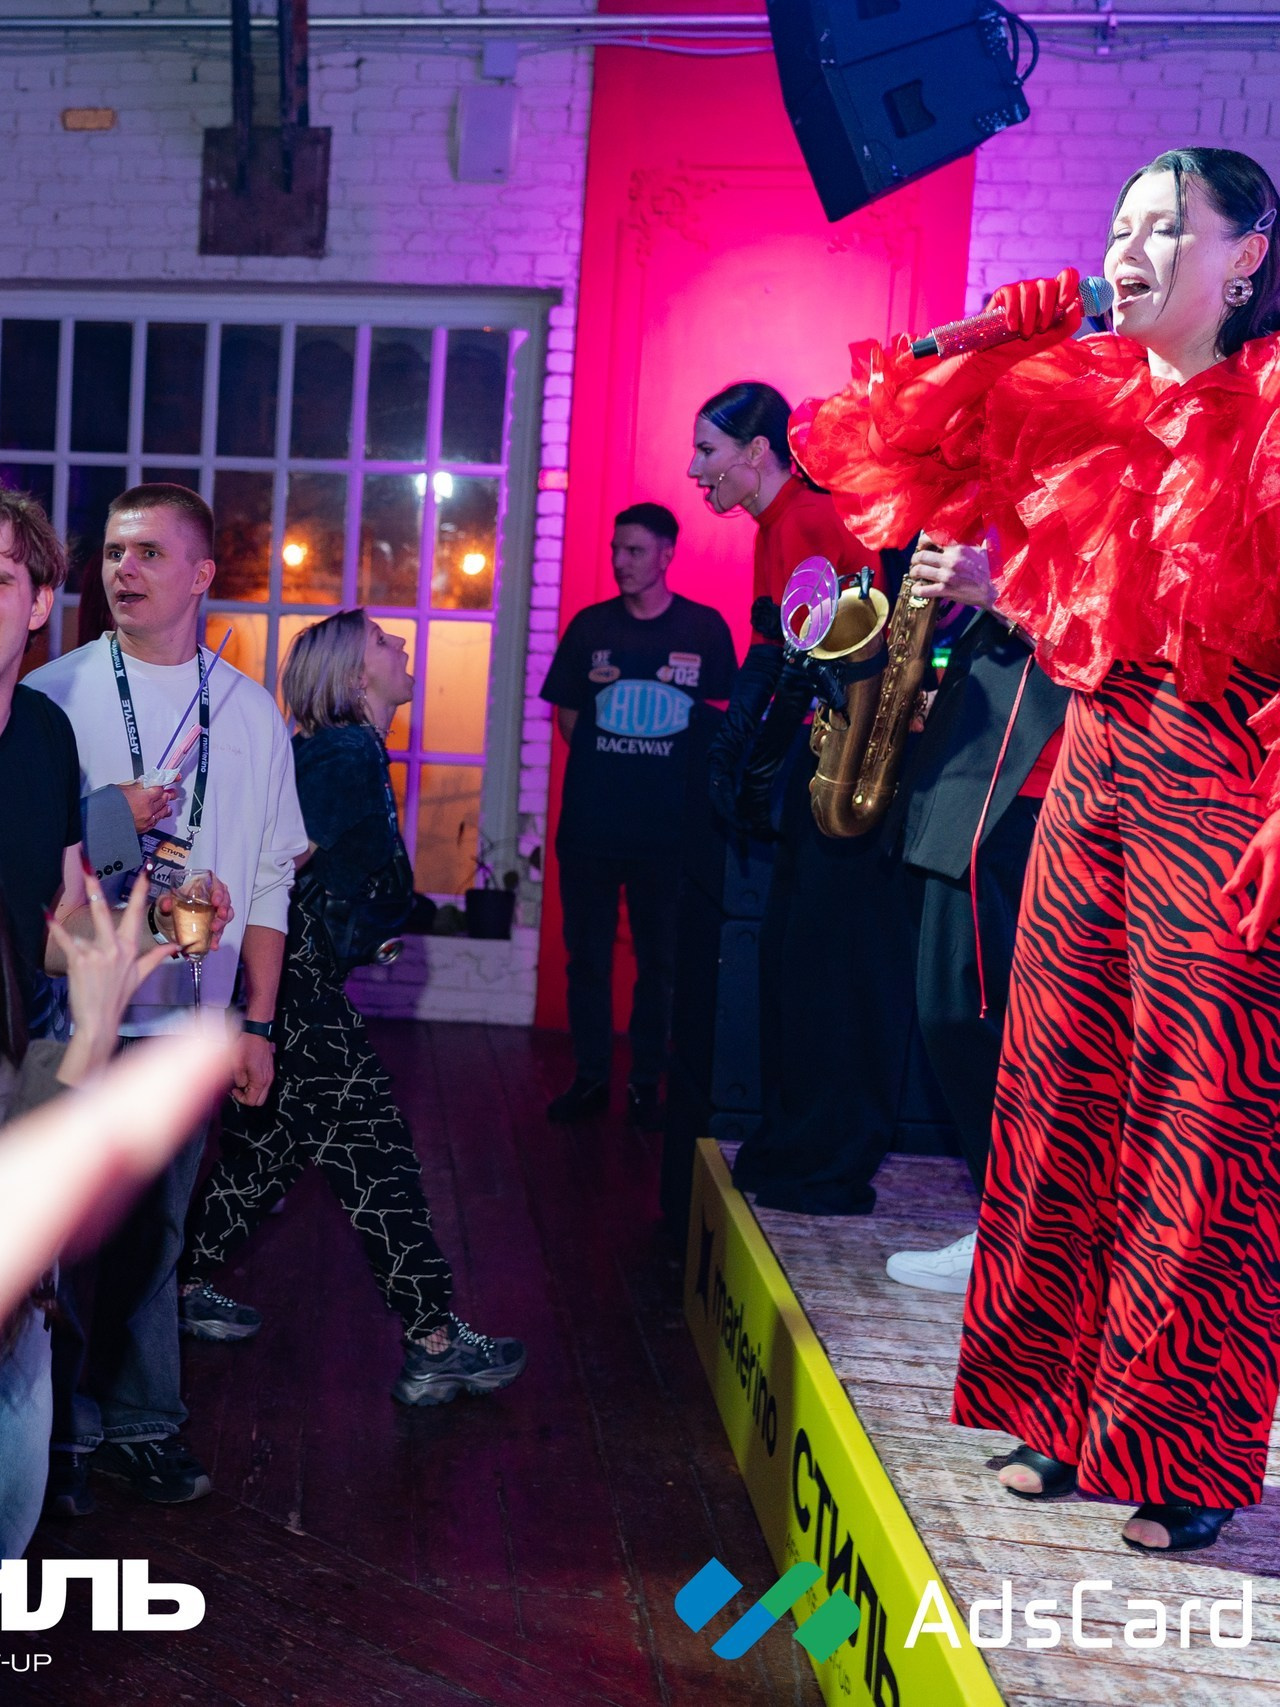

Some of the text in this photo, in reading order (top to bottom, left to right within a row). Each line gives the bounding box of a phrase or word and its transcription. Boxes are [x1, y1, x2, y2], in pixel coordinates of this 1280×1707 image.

[122, 699, 140, 755] AFFSTYLE
[596, 736, 674, 756] RACEWAY
[713, 1267, 778, 1457] marlerino
[792, 1427, 901, 1707] СТИЛЬ
